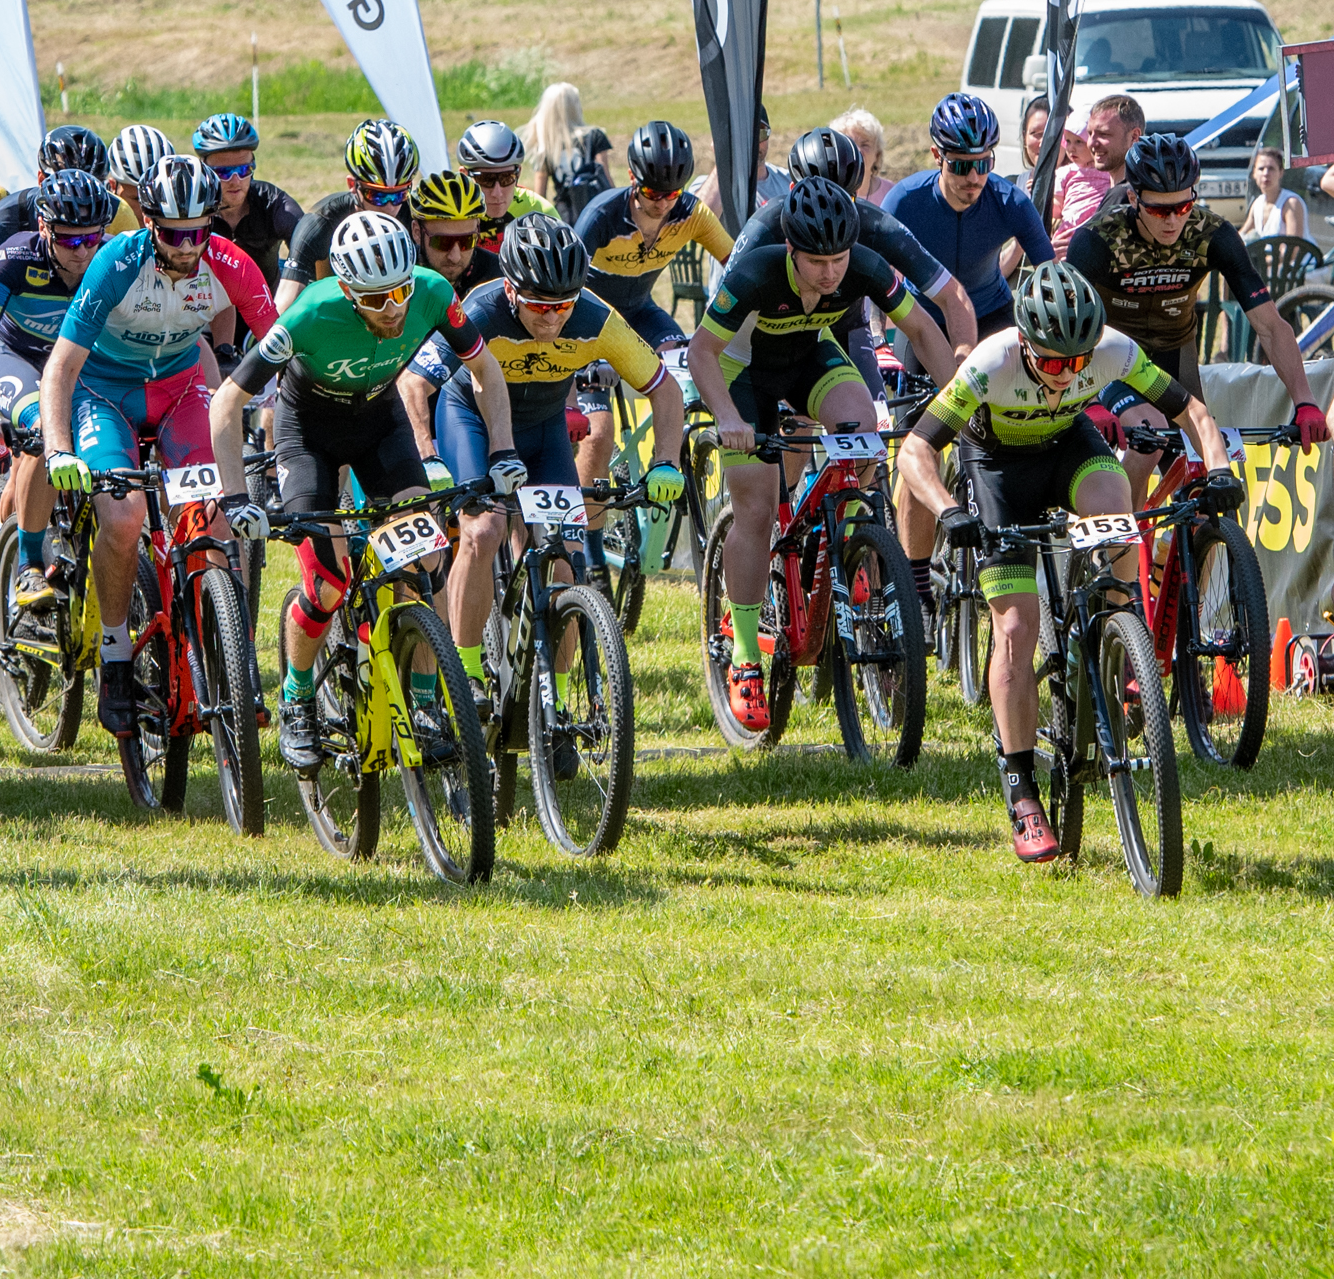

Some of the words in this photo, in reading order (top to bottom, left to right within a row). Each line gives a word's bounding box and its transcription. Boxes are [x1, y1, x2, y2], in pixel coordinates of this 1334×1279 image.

[214, 251, 240, 269] SELS
[1120, 273, 1191, 287] PATRIA
[835, 435, 870, 450] 51
[179, 467, 216, 489] 40
[533, 489, 571, 510] 36
[377, 516, 435, 554] 158
[1074, 517, 1133, 537] 153
[15, 643, 45, 657] SCOTT
[538, 672, 554, 709] FOX
